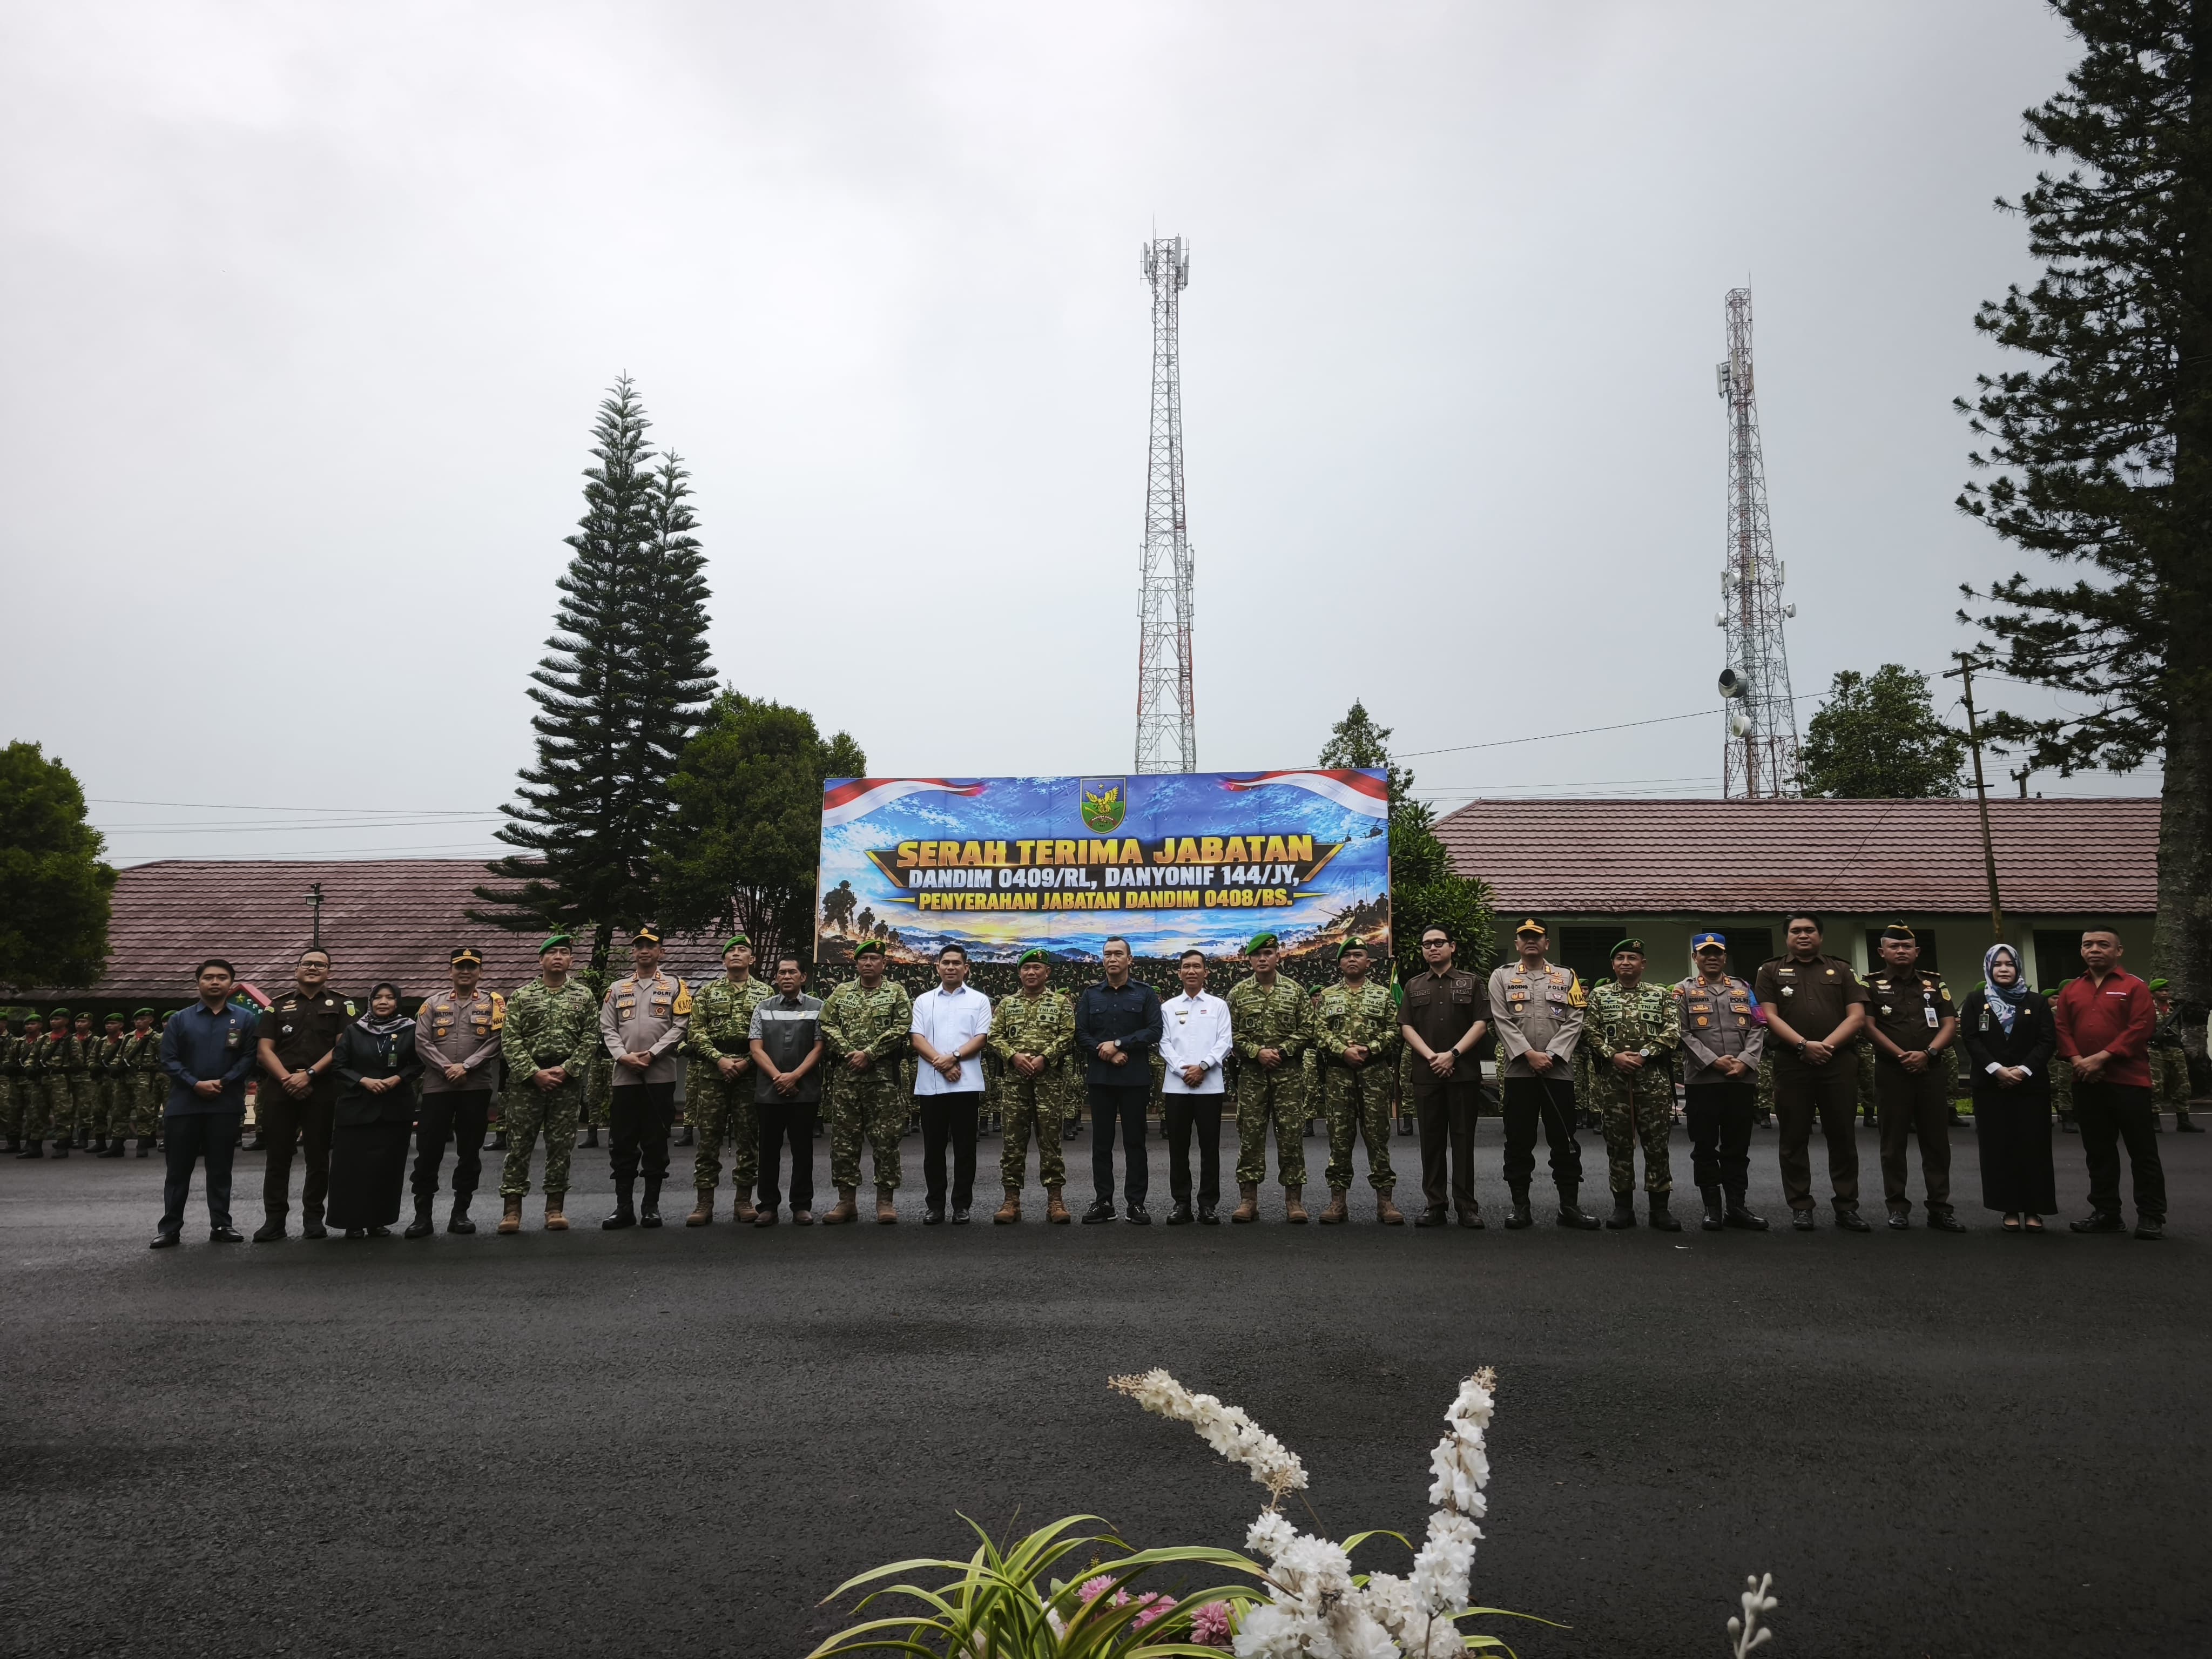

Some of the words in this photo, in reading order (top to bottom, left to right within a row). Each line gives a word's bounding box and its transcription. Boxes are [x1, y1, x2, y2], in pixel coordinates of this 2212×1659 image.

[896, 841, 1007, 867] SERAH
[1016, 839, 1143, 865] TERIMA
[1153, 835, 1313, 864] JABATAN
[908, 869, 993, 888] DANDIM
[999, 868, 1097, 890] 0409/RL,
[1105, 866, 1215, 886] DANYONIF
[1220, 864, 1300, 886] 144/JY,
[919, 892, 1037, 910] PENYERAHAN
[1042, 891, 1120, 909] JABATAN
[1125, 890, 1199, 908] DANDIM
[1205, 888, 1293, 907] 0408/BS.
